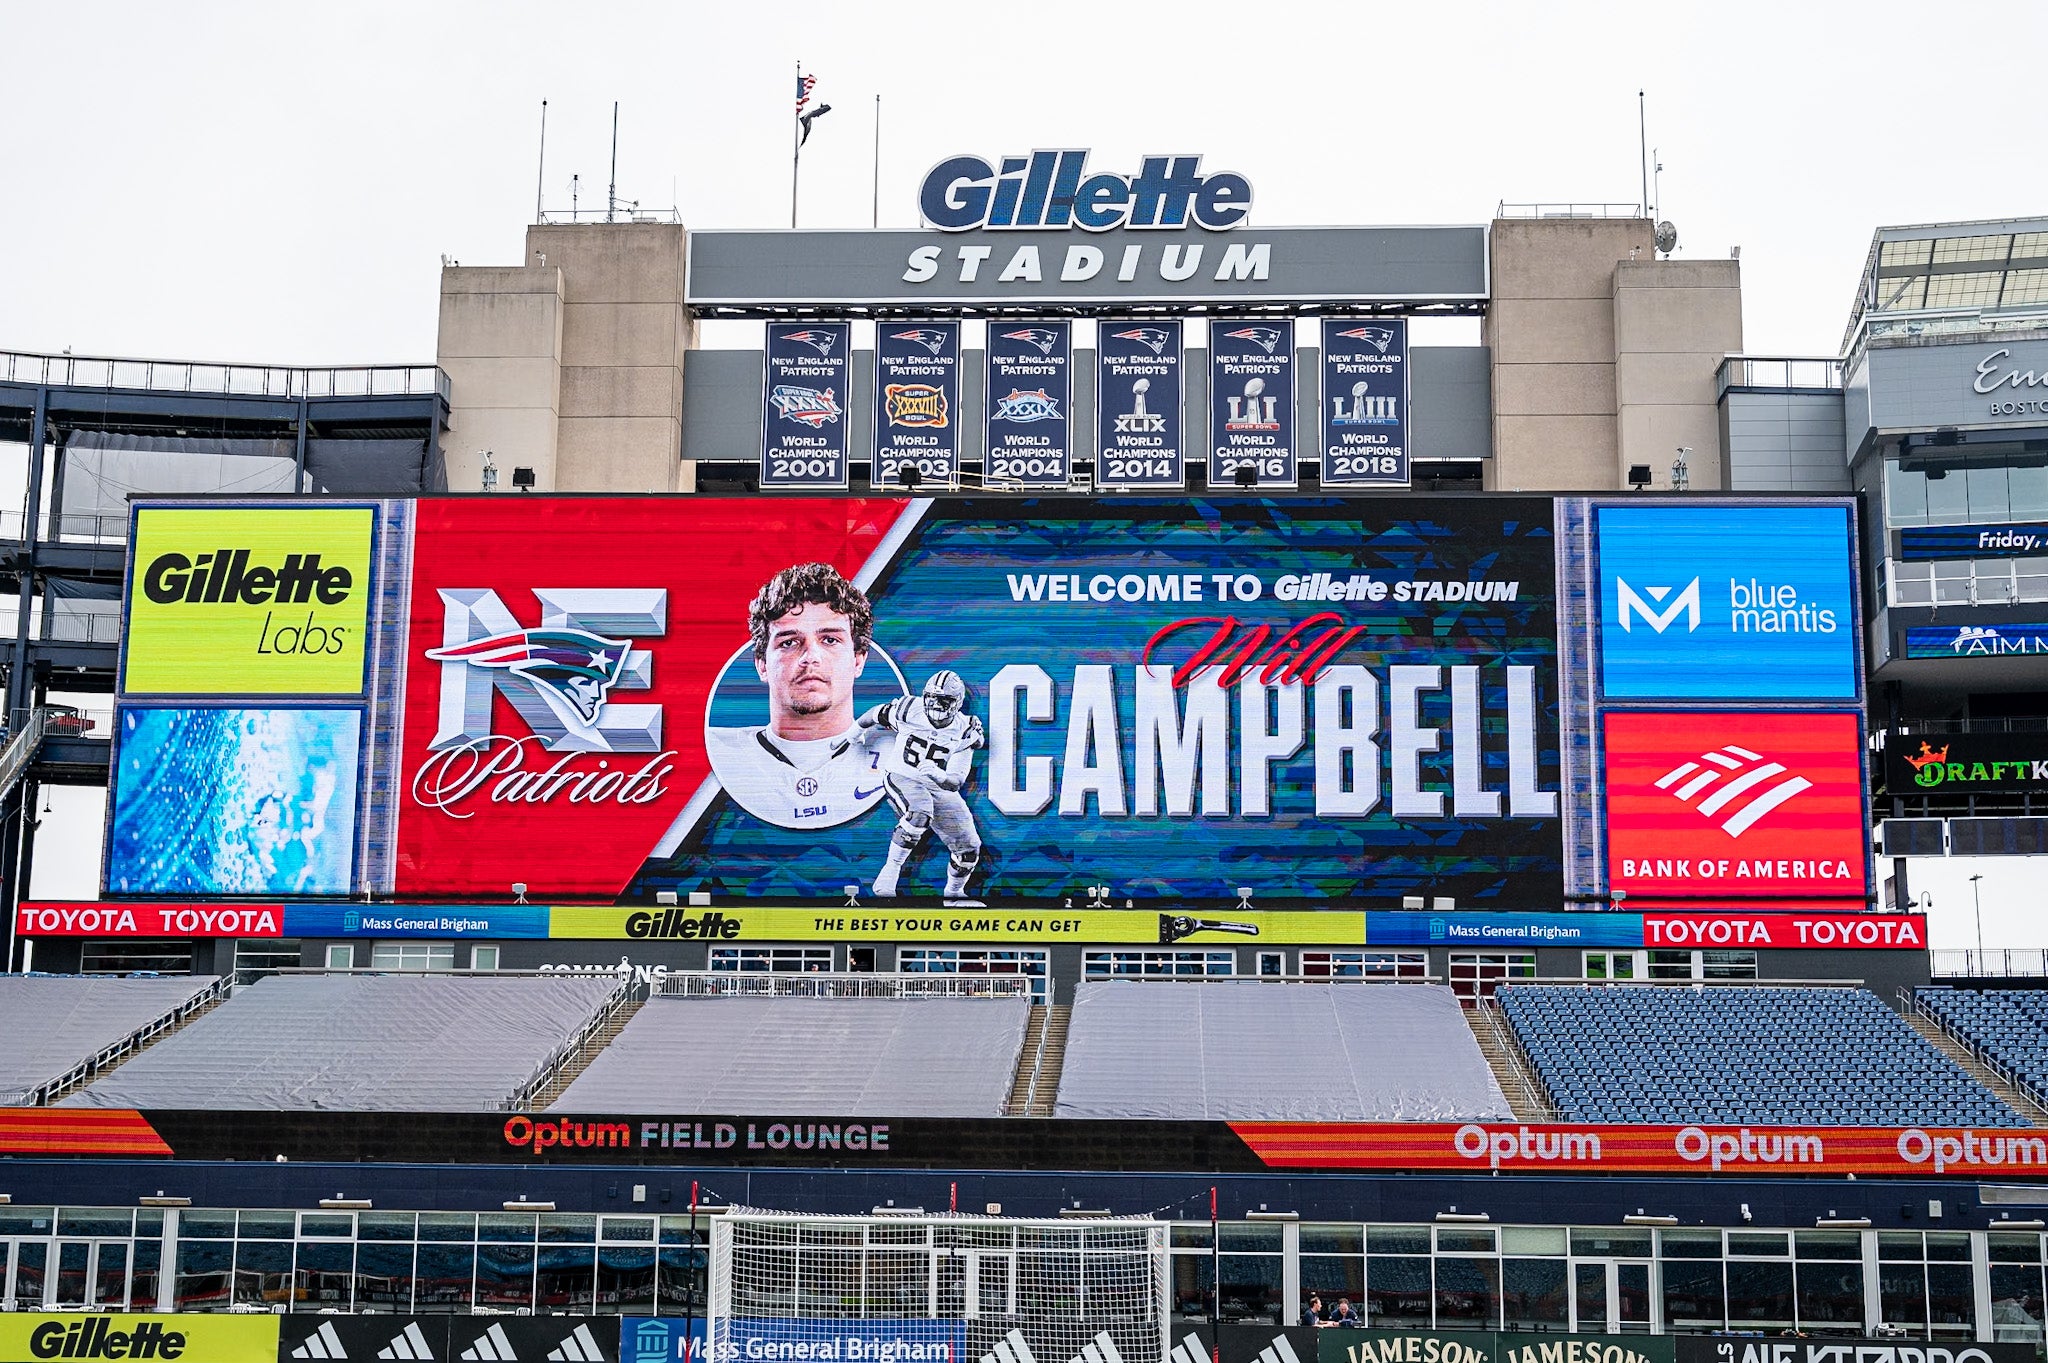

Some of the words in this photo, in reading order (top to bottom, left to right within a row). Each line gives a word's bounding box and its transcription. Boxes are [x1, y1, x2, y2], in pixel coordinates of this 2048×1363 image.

[919, 149, 1253, 231] Gillette
[902, 244, 1271, 282] STADIUM
[1973, 348, 2048, 394] En
[1001, 402, 1056, 415] XXXIX
[1114, 419, 1166, 432] XLIX
[772, 460, 836, 477] 2001
[992, 460, 1062, 477] 2004
[1108, 460, 1172, 477] 2014
[1334, 457, 1397, 474] 2018
[1979, 530, 2041, 550] Friday,
[144, 550, 352, 604] Gillette
[1007, 575, 1202, 601] WELCOME
[1213, 575, 1262, 601] TO
[1274, 573, 1387, 602] Gillette
[1393, 582, 1518, 602] STADIUM
[1730, 578, 1796, 608] blue
[1732, 602, 1836, 633] mantis
[257, 611, 344, 655] Labs
[1144, 612, 1368, 688] Will
[988, 664, 1558, 818] CAMPBELL
[868, 751, 880, 769] 7
[412, 734, 679, 818] Patriots
[798, 778, 818, 796] SEC
[794, 806, 827, 818] LSU
[1624, 860, 1691, 878] BANK
[1698, 860, 1728, 878] OF
[1736, 860, 1850, 878] AMERICA
[21, 908, 137, 932] TOYOTA
[159, 910, 276, 933] TOYOTA
[363, 917, 394, 930] Mass
[397, 917, 438, 931] General
[441, 917, 488, 934] Brigham
[625, 909, 740, 938] Gillette
[815, 918, 844, 931] THE
[850, 918, 890, 932] BEST
[895, 919, 945, 932] YOUR
[950, 919, 1000, 932] GAME
[1006, 919, 1043, 932] CAN
[1050, 920, 1082, 932] GET
[1450, 925, 1480, 937] Mass
[1482, 925, 1528, 938] General
[1531, 925, 1580, 940] Brigham
[1646, 920, 1772, 944] TOYOTA
[1794, 920, 1919, 944] TOYOTA
[504, 1116, 630, 1154] Optum
[641, 1122, 736, 1149] FIELD
[748, 1124, 890, 1150] LOUNGE
[1454, 1124, 1601, 1168] Optum
[1675, 1127, 1823, 1171] Optum
[1897, 1129, 2048, 1173] Optum
[989, 1204, 999, 1212] EXIT
[30, 1318, 186, 1359] Gillette
[746, 1336, 840, 1360] General
[848, 1336, 950, 1363] Brigham
[1347, 1337, 1483, 1363] JAMESON
[1507, 1342, 1645, 1363] JAMESON
